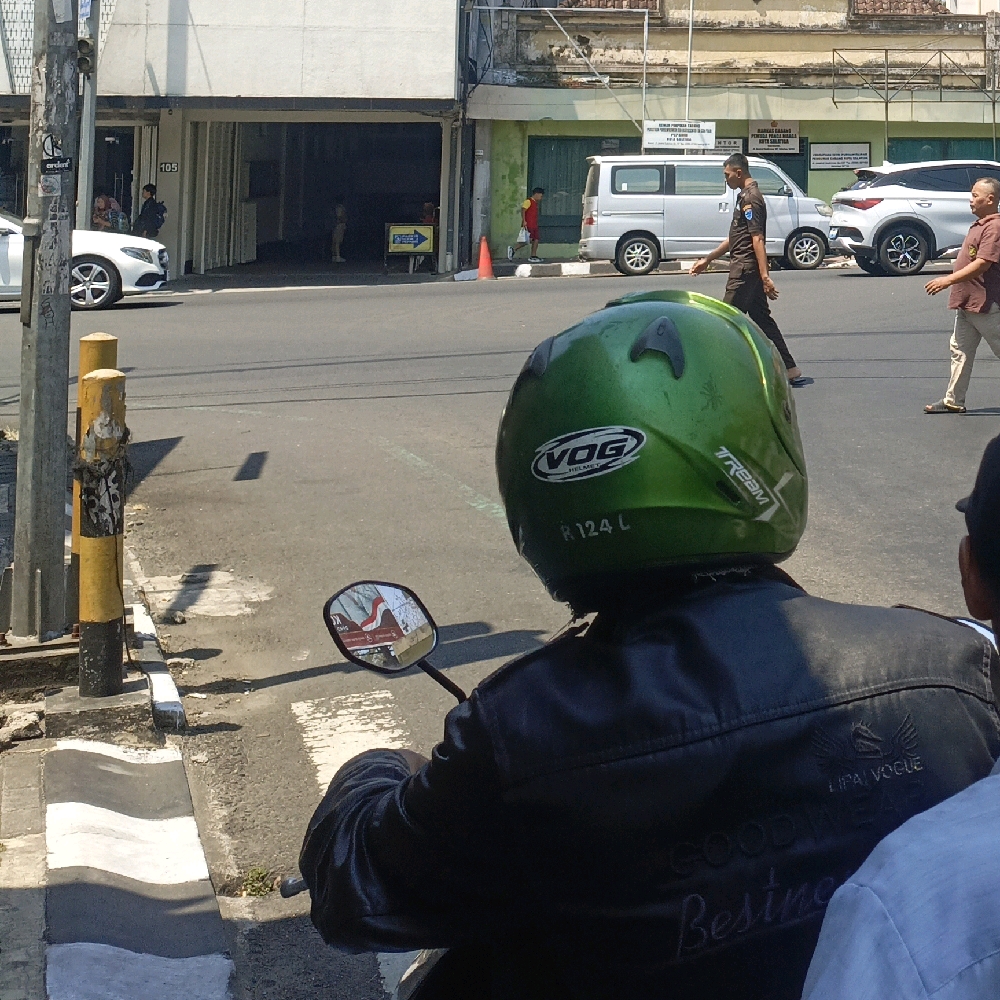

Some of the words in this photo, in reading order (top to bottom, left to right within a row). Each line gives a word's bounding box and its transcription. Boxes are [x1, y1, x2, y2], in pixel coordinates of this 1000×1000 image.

[160, 163, 178, 172] 105
[546, 437, 630, 471] VOG
[567, 462, 601, 474] HELMET
[576, 518, 613, 539] 124
[870, 756, 924, 782] VOGUE
